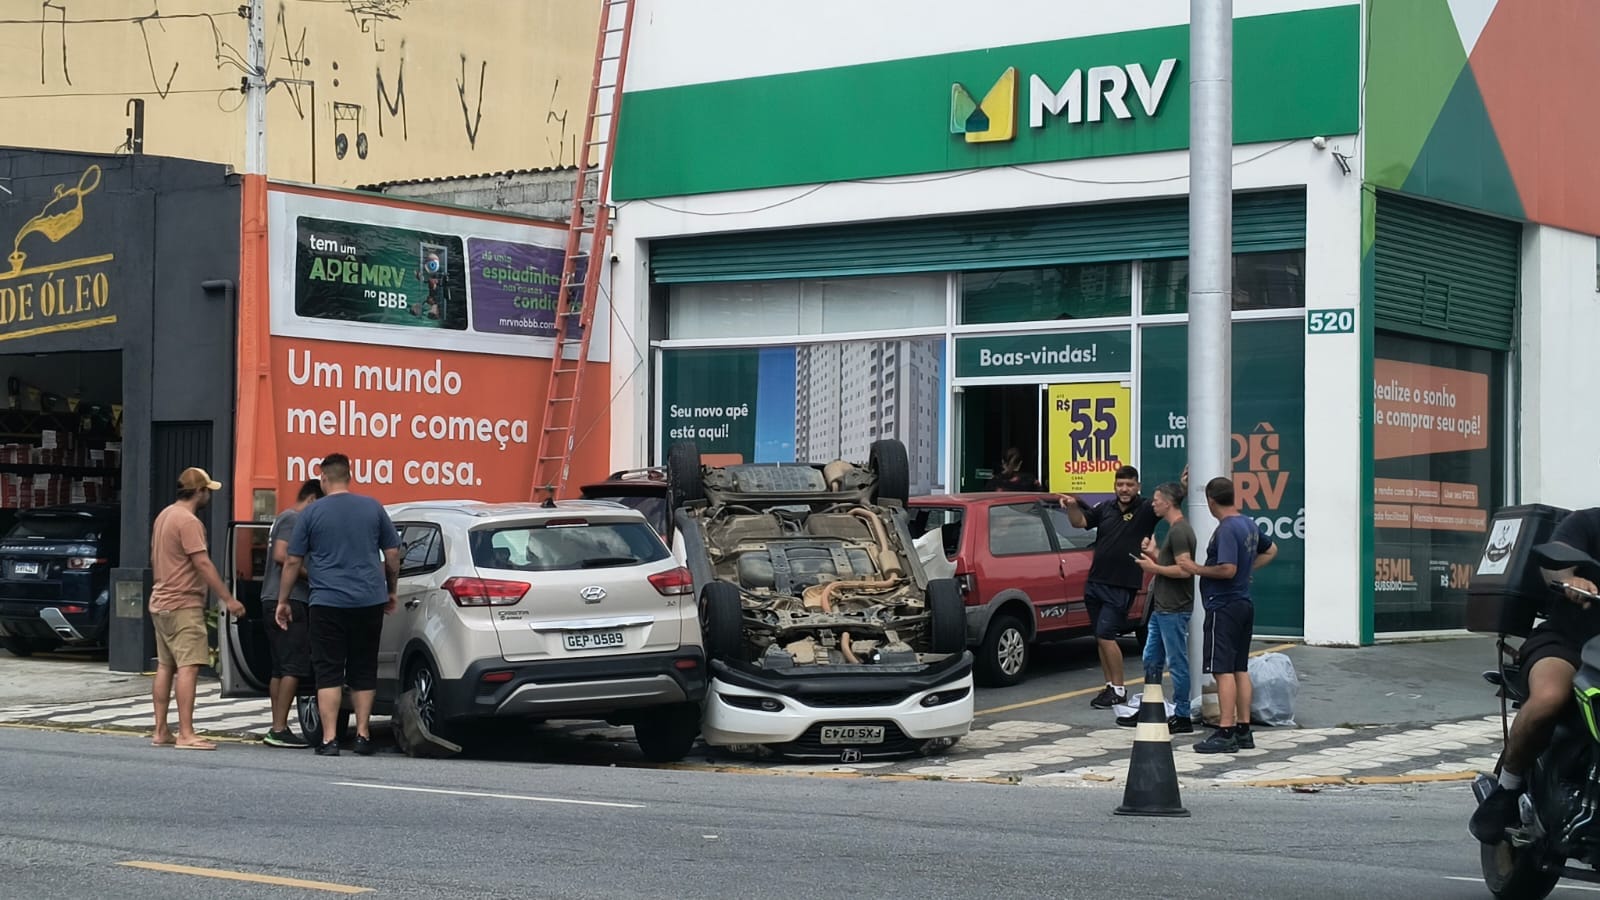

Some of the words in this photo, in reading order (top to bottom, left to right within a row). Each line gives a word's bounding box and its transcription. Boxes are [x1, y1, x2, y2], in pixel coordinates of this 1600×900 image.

[1029, 58, 1177, 128] MRV
[309, 234, 338, 252] tem
[340, 244, 356, 255] um
[0, 283, 34, 325] DE
[39, 272, 109, 316] ÓLEO
[364, 288, 377, 299] no
[378, 291, 408, 309] BBB
[1309, 312, 1352, 332] 520
[980, 344, 1097, 367] Boas-vindas!
[288, 349, 343, 388] Um
[354, 359, 462, 395] mundo
[1413, 389, 1421, 404] o
[1423, 386, 1456, 408] sonho
[670, 405, 692, 418] Seu
[694, 406, 723, 418] novo
[725, 403, 749, 420] apê
[1056, 399, 1070, 412] R$
[1069, 398, 1117, 440] 55
[1168, 412, 1188, 430] te
[287, 400, 402, 438] melhor
[411, 414, 528, 450] começa
[670, 424, 695, 439] está
[698, 423, 729, 442] aqui!
[1386, 411, 1435, 433] comprar
[1437, 416, 1455, 432] seu
[1457, 414, 1481, 439] apê!
[1071, 436, 1118, 461] MIL
[1155, 434, 1185, 448] um
[403, 459, 482, 486] casa.
[1233, 471, 1290, 510] RV
